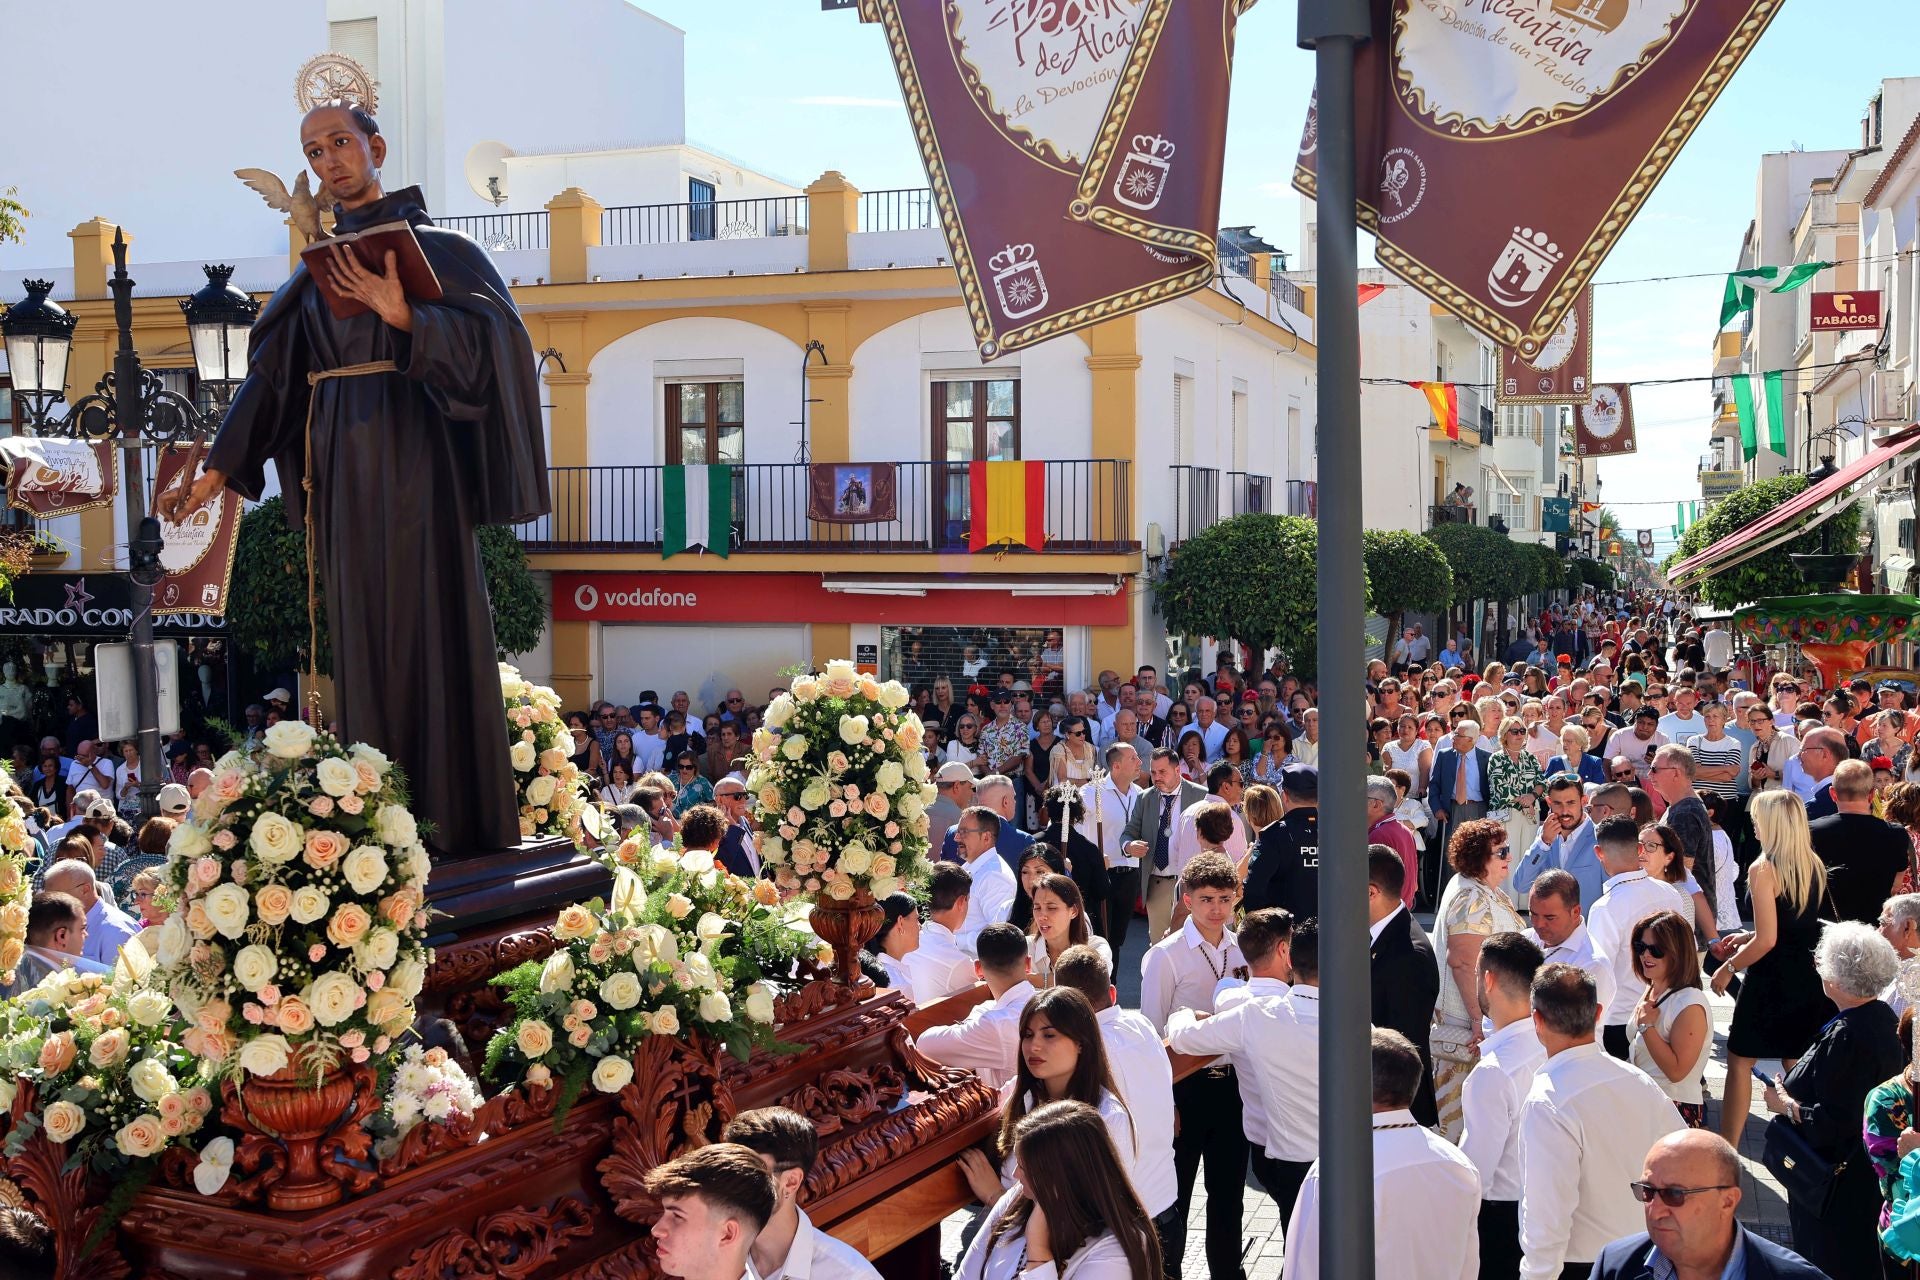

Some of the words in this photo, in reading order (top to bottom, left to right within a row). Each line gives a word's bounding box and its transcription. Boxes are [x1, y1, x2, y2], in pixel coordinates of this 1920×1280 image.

[1036, 42, 1062, 76] de
[1061, 19, 1139, 75] Alcá
[1440, 6, 1487, 39] Devoción
[1487, 26, 1508, 45] de
[1509, 42, 1530, 59] un
[1536, 53, 1587, 94] Pueblo
[1036, 67, 1118, 105] Devoción
[1152, 252, 1179, 264] PEDRO
[1814, 314, 1876, 326] TABACOS
[605, 587, 697, 607] vodafone
